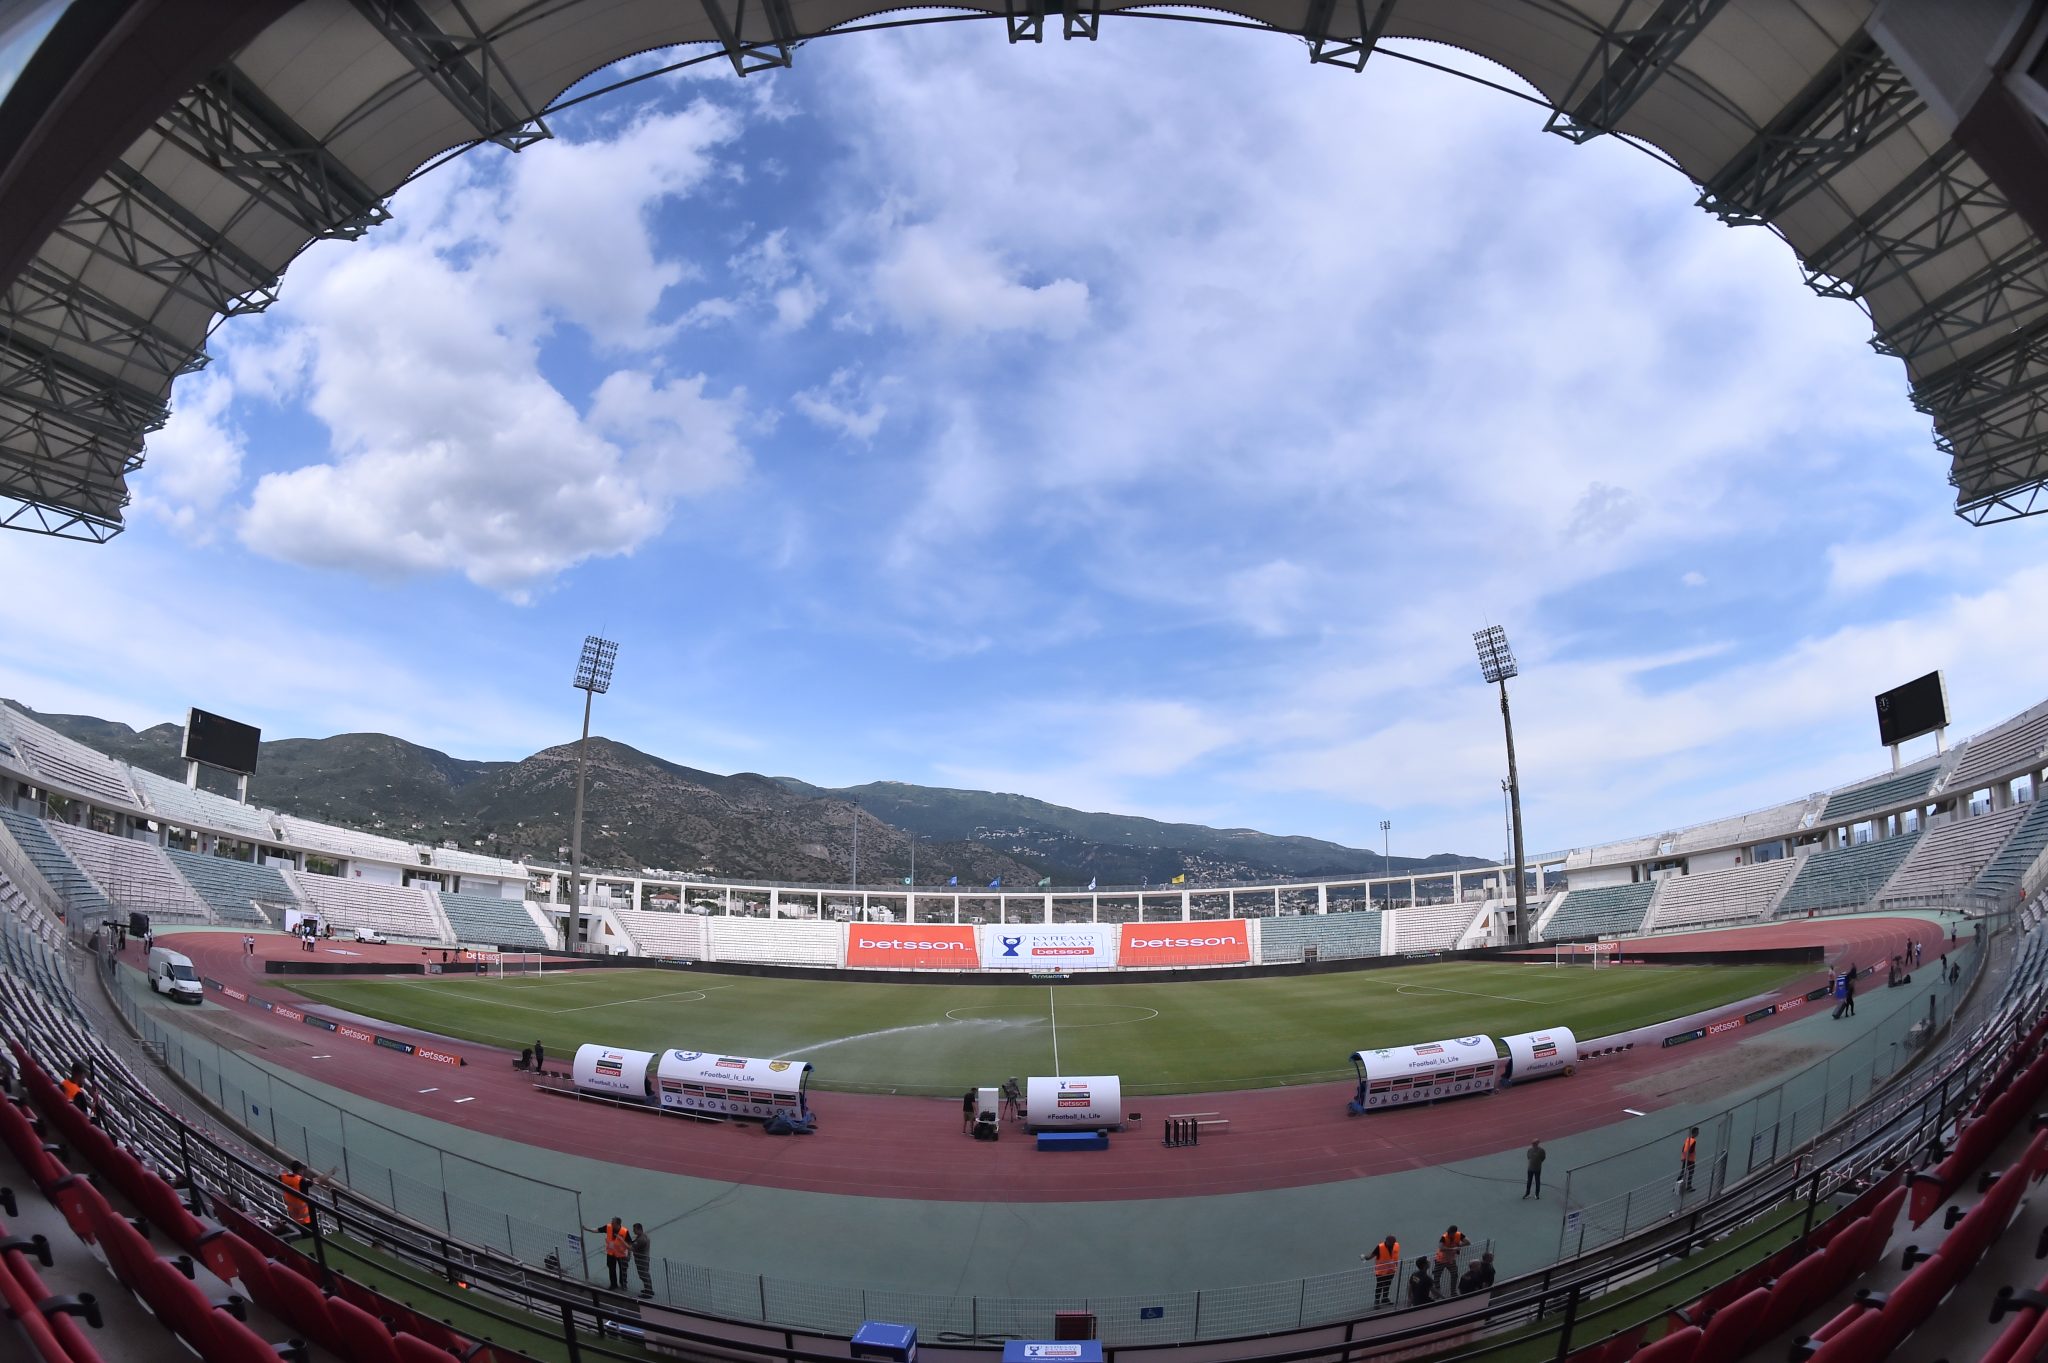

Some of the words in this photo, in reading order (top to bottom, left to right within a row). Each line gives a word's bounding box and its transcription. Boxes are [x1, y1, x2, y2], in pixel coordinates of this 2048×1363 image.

[859, 938, 964, 950] betsson
[1130, 936, 1236, 948] betsson
[1037, 947, 1090, 955] betsson
[224, 987, 244, 1001] betsson
[1778, 997, 1803, 1011] betsson
[276, 1006, 300, 1021] betsson
[1709, 1019, 1740, 1034] betsson
[340, 1027, 370, 1042] betsson
[419, 1048, 454, 1064] betsson
